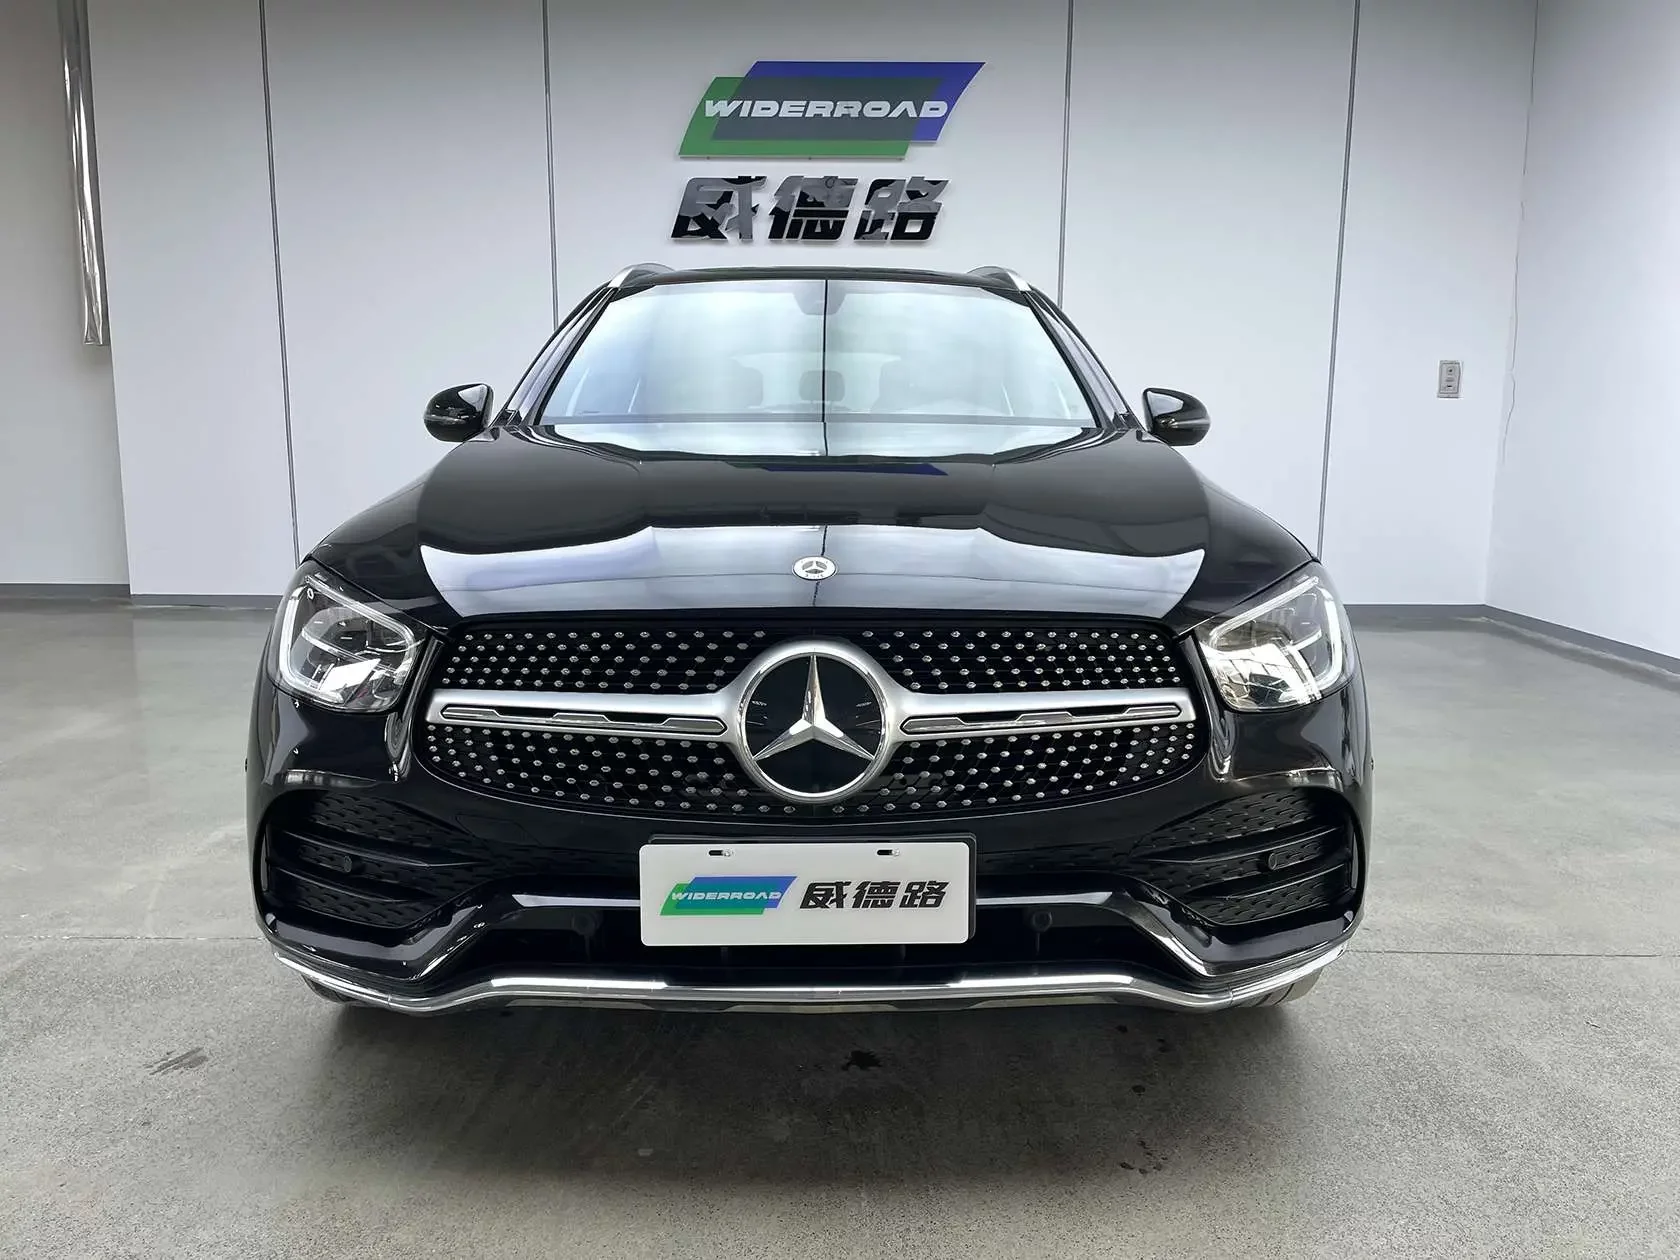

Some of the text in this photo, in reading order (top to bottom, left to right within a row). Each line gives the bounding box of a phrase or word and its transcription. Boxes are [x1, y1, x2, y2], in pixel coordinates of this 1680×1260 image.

[704, 100, 949, 118] WIDERROAD
[671, 175, 950, 240] 威德路
[671, 891, 782, 900] WIDERROAD
[799, 880, 949, 909] 威德路
